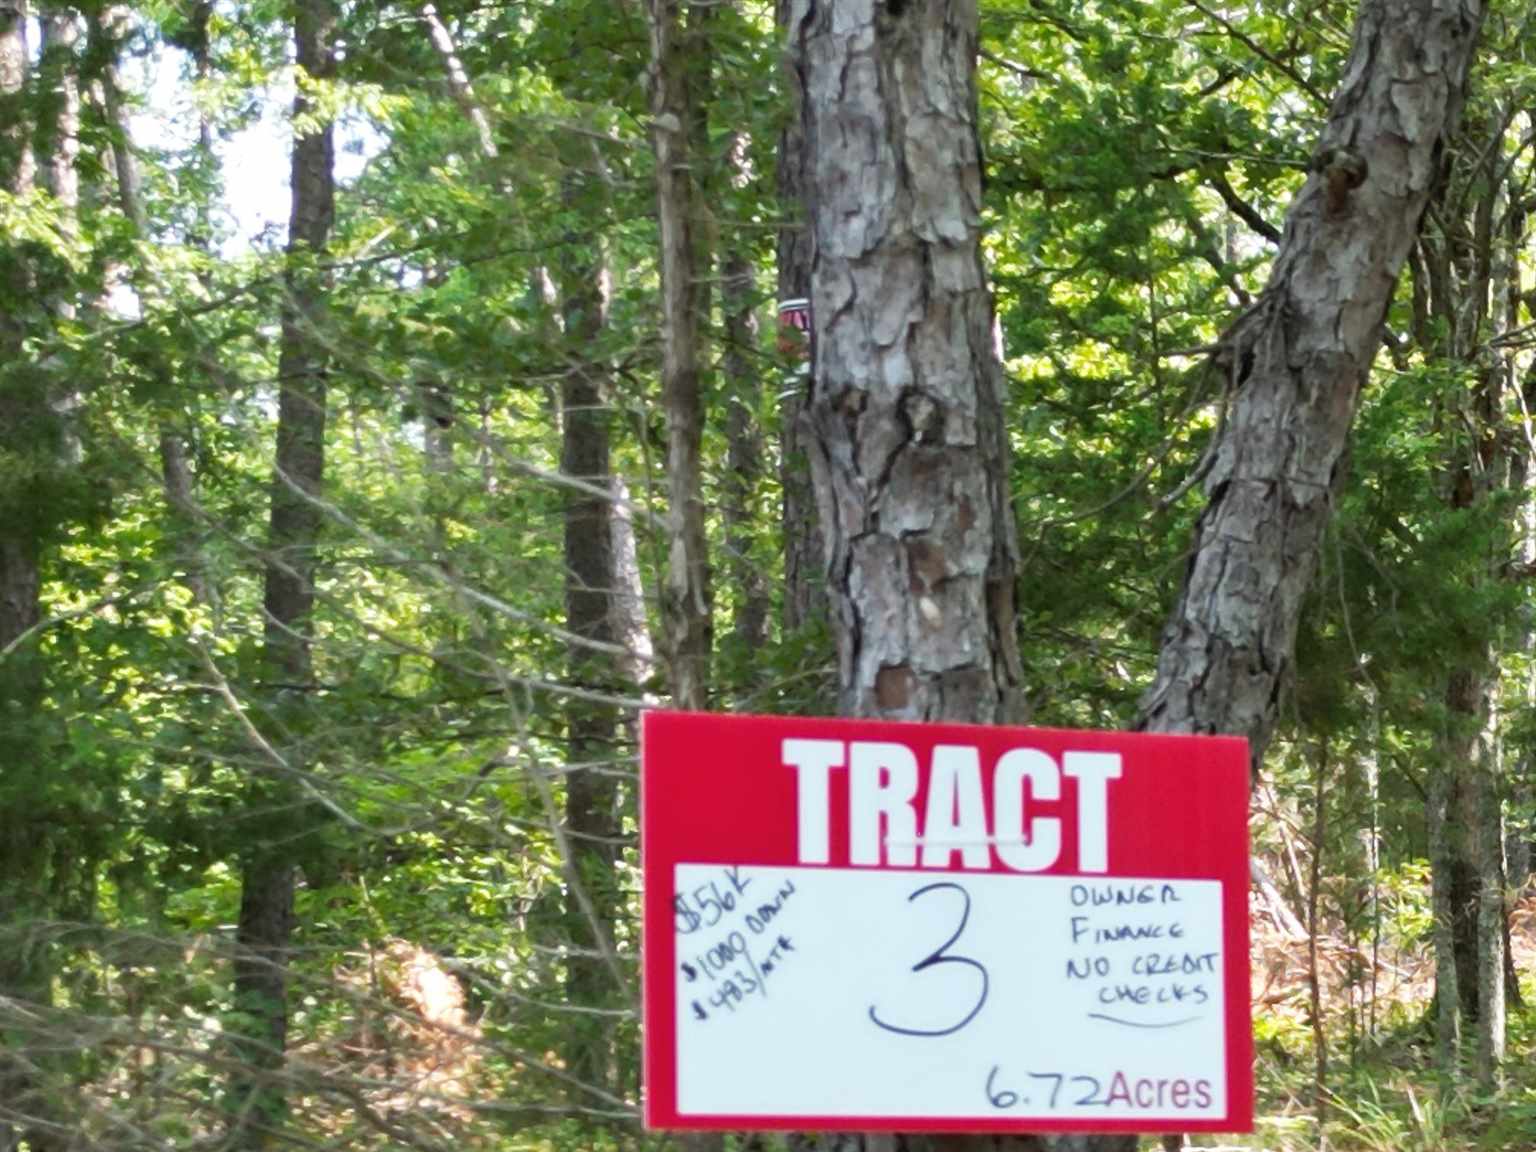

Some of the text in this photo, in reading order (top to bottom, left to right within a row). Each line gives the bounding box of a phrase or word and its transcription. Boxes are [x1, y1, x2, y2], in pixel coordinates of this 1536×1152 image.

[782, 739, 1122, 873] TRACT
[869, 882, 989, 1036] 3
[1066, 951, 1220, 980] NO CREDIT
[1097, 983, 1209, 1006] CHECKS
[985, 1066, 1212, 1109] 6.72 Acres
